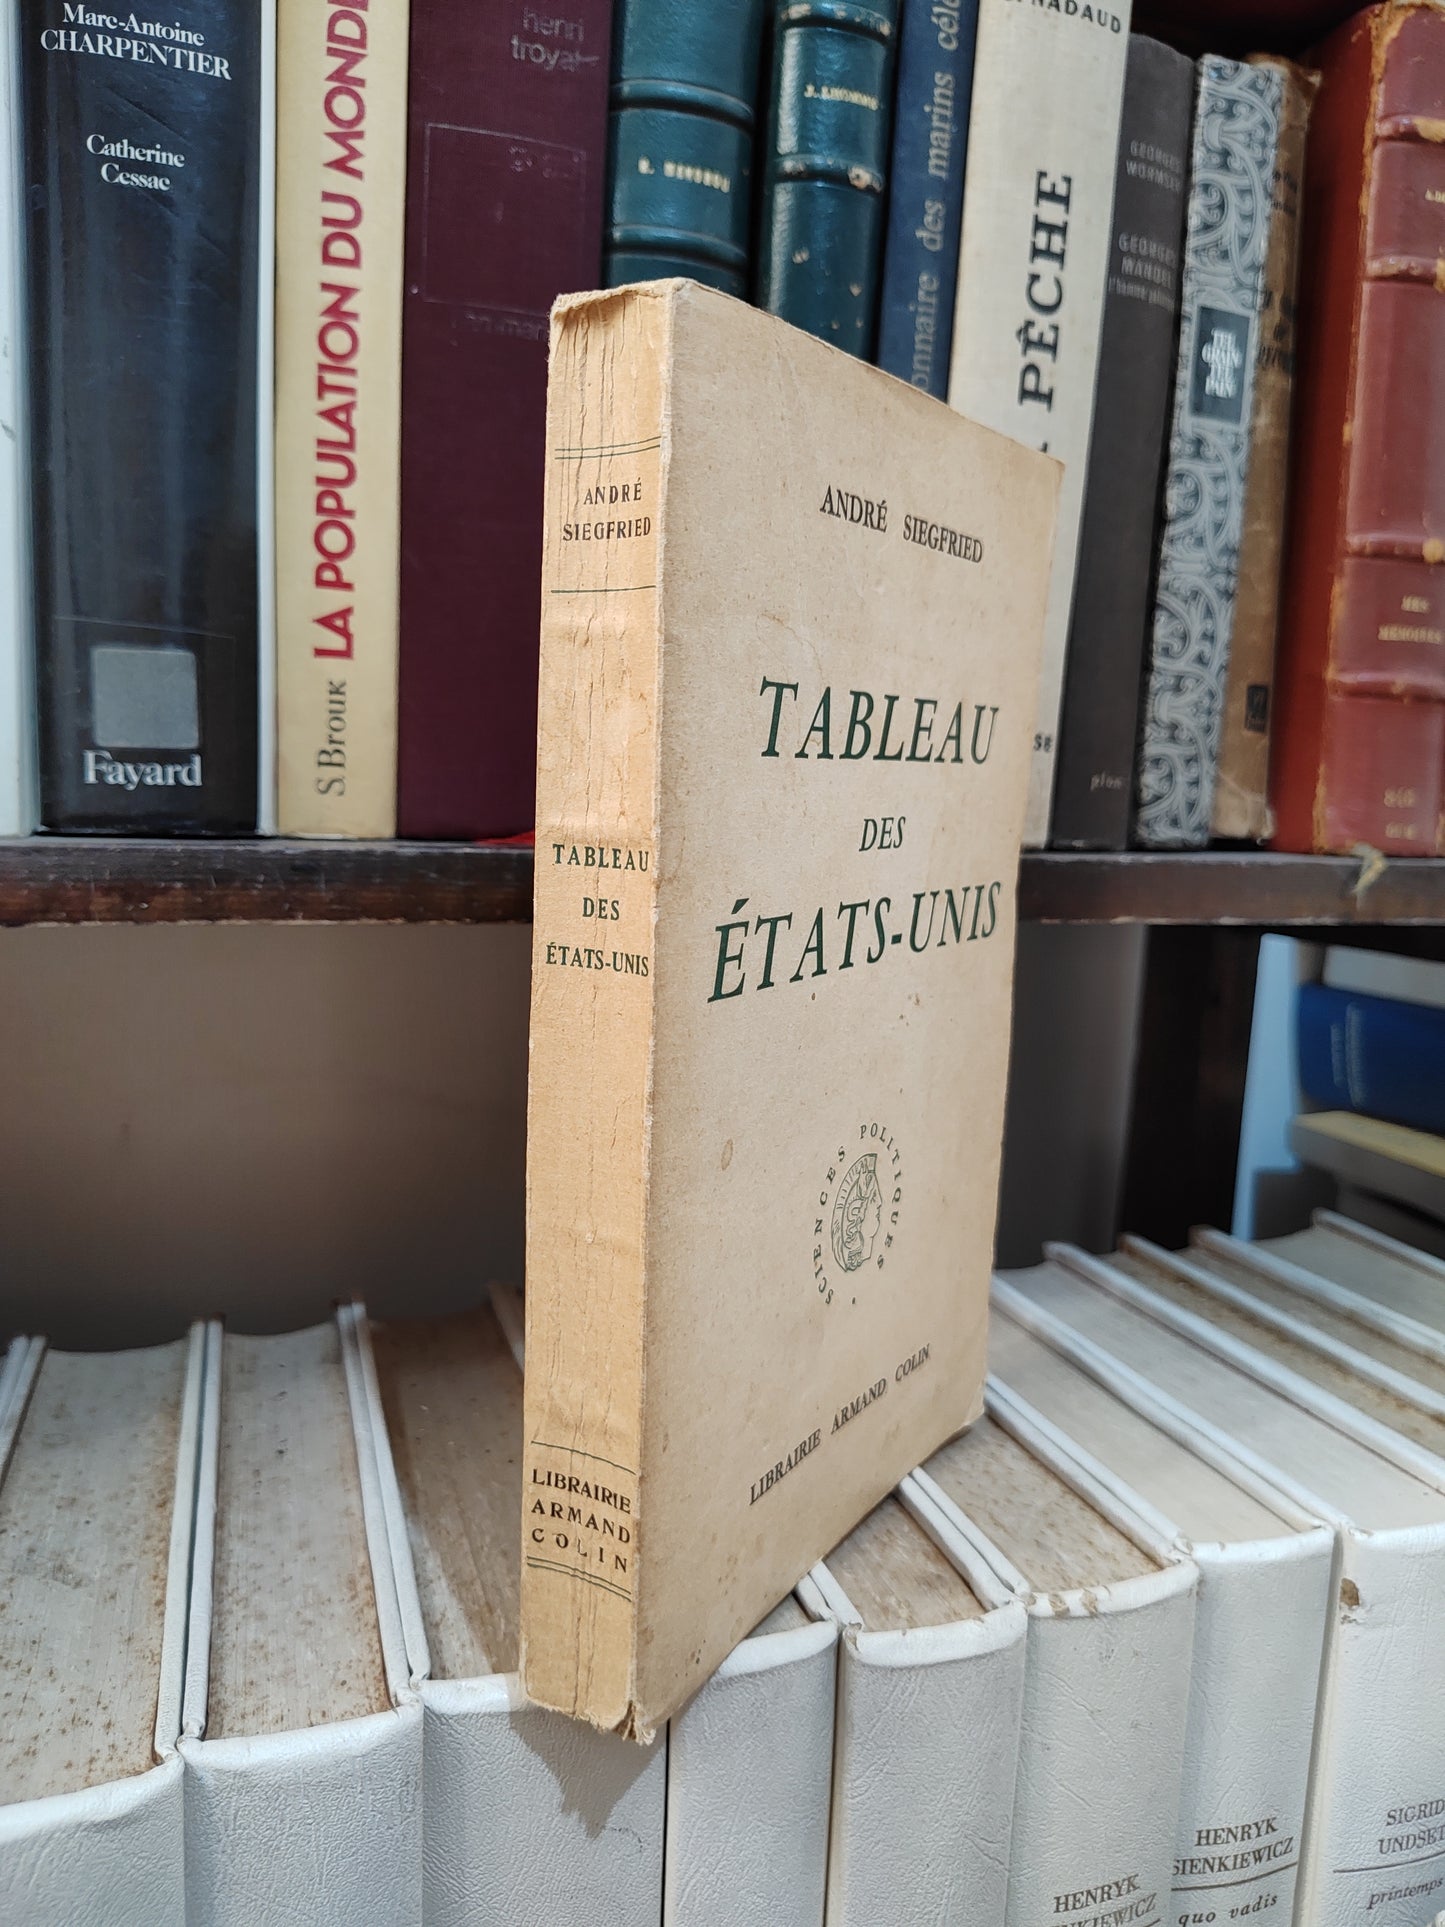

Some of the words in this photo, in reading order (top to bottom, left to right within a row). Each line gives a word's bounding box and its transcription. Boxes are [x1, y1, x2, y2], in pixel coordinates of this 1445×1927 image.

[63, 2, 205, 47] Marc-Antoine
[40, 29, 232, 80] CHARPENTIER
[923, 71, 956, 181] marins
[86, 133, 185, 168] Catherine
[100, 162, 172, 191] Cessac
[321, 190, 364, 269] DU
[915, 199, 945, 252] des
[1015, 170, 1072, 412] PÊCHE
[312, 282, 361, 592] POPULATION
[583, 477, 642, 505] ANDRÉ
[563, 516, 651, 541] SIEGFRIED
[819, 484, 888, 533] ANDRÉ
[903, 514, 983, 564] SIEGFRIED
[312, 605, 355, 660] LA
[759, 676, 999, 765] TABLEAU
[83, 750, 203, 790] Fayard
[858, 816, 906, 852] DES
[552, 843, 649, 872] TABLEAU
[582, 896, 620, 921] DES
[545, 941, 649, 977] ÉTATS-UNIS
[707, 881, 1002, 1003] ÉTATS-UNIS
[813, 1146, 847, 1305] SCIENCES
[859, 1123, 902, 1270] POLITIQUES
[750, 1428, 821, 1506] LIBRAIRIE
[831, 1378, 887, 1435] ARMAND
[895, 1343, 930, 1382] COLIN
[532, 1468, 631, 1514] LIBRAIRIE
[531, 1498, 631, 1544] ARMAND
[531, 1528, 628, 1573] COLIN
[1194, 1817, 1279, 1847] HENRYK
[1386, 1799, 1445, 1827] SIGRID
[1053, 1874, 1139, 1913] HENRYK
[1178, 1912, 1216, 1927] quo
[1229, 1894, 1278, 1919] vadis
[1367, 1878, 1444, 1910] printemps
